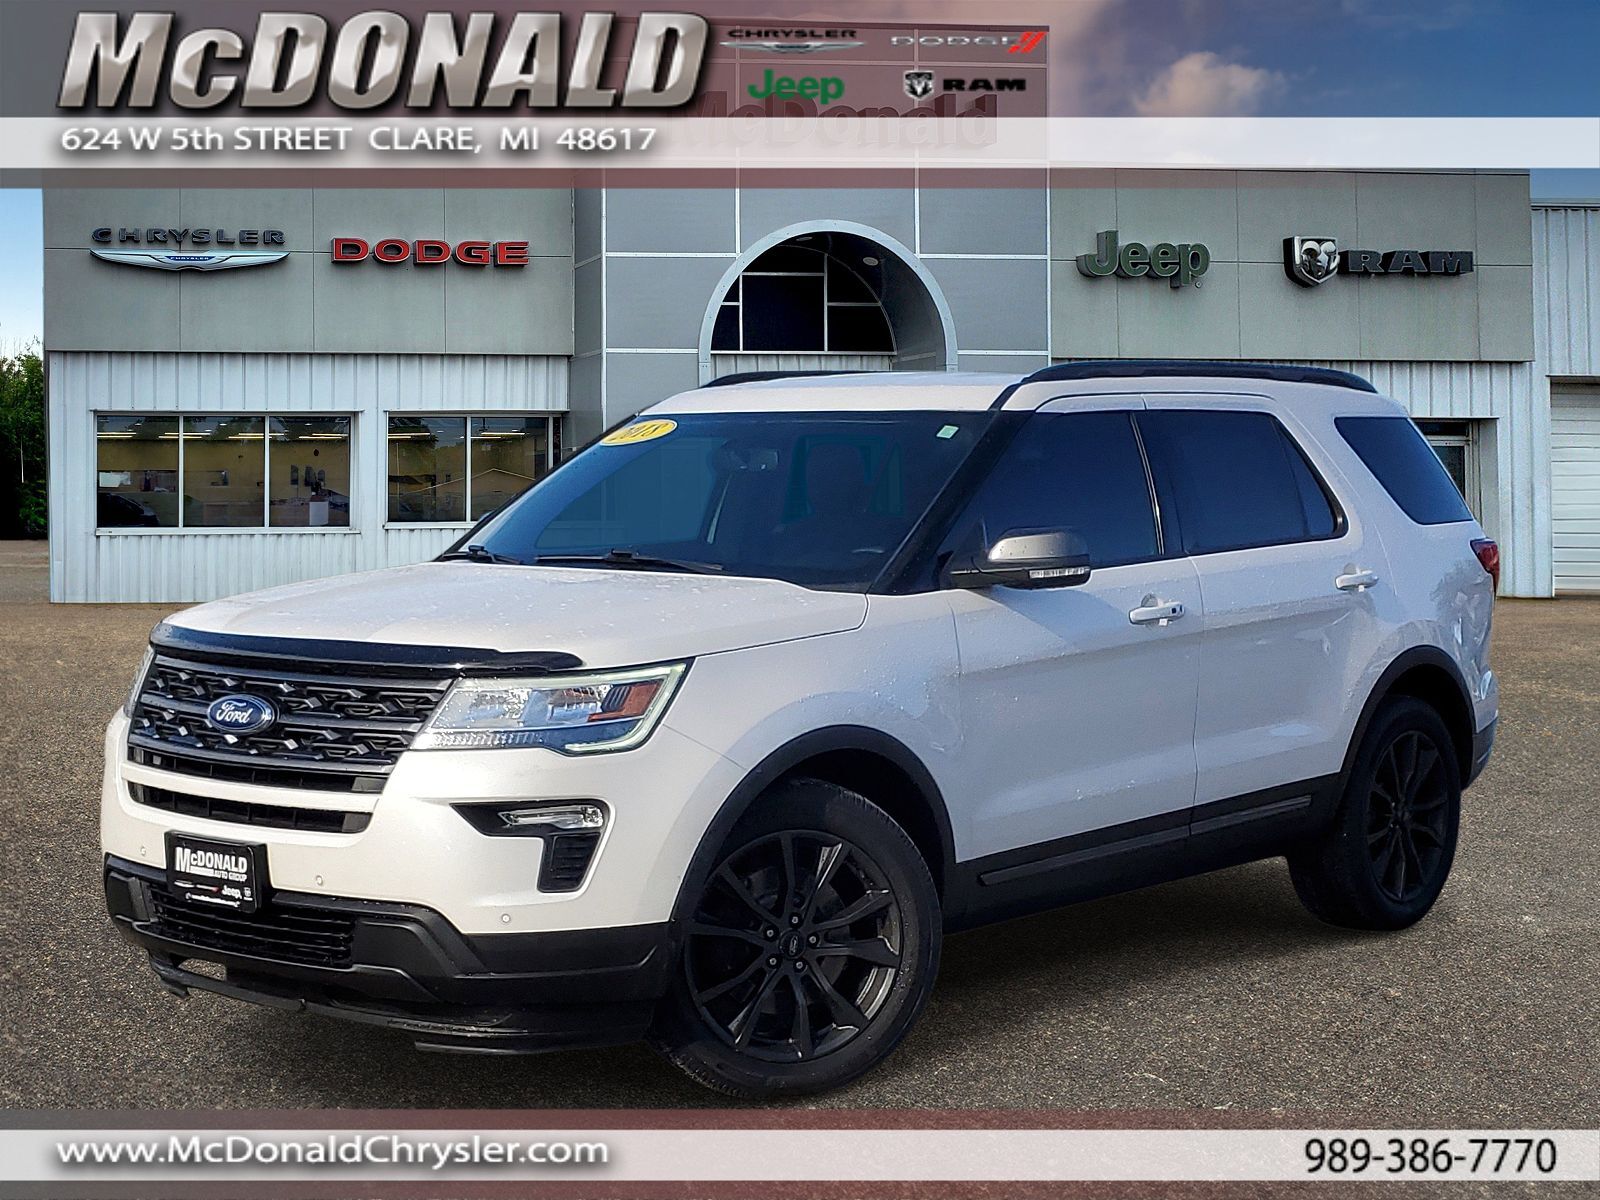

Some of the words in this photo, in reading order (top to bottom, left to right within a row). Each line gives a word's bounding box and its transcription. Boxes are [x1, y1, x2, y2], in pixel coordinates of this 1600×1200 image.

[91, 227, 286, 245] CHRYSLER
[331, 237, 530, 266] DODGE
[1076, 229, 1211, 289] Jeep
[1341, 249, 1475, 276] RAM
[216, 700, 254, 724] Ford
[175, 846, 248, 873] McDONALD
